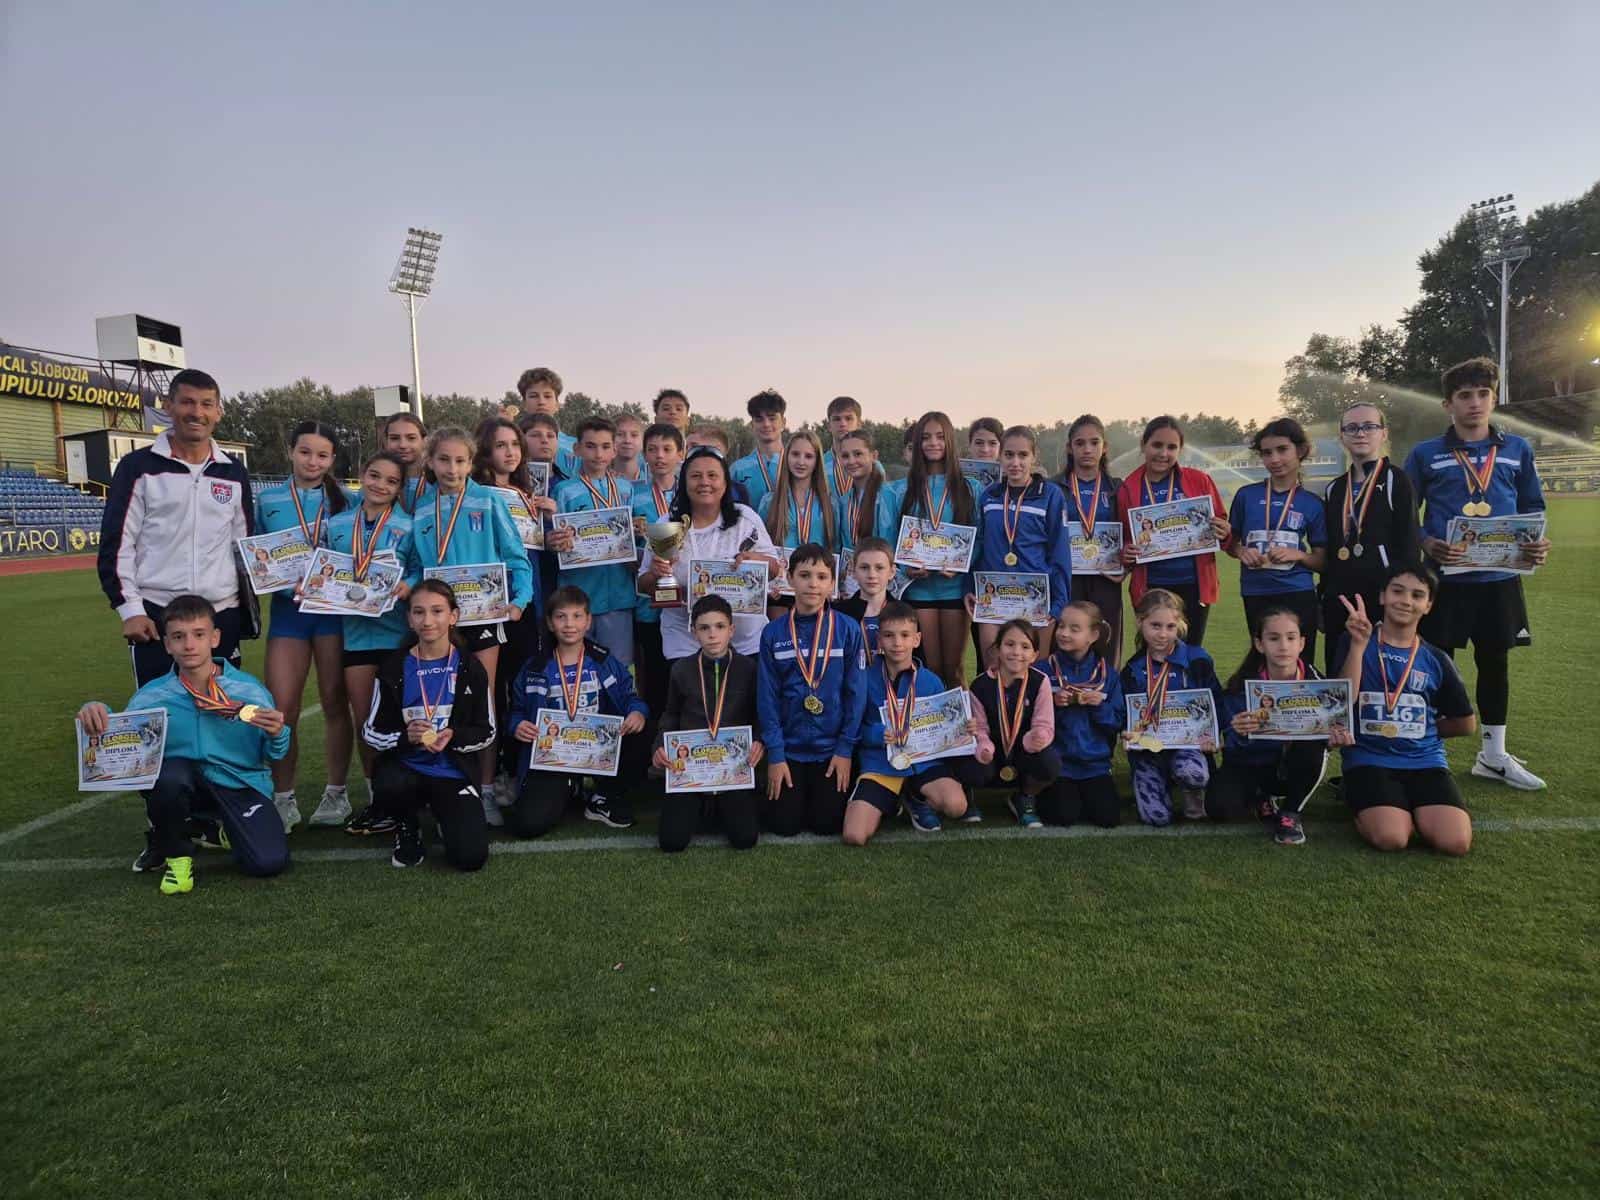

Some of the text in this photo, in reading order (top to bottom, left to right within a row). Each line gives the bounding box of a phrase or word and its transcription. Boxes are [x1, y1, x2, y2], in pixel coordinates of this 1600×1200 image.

[0, 356, 89, 384] CAL SLOBOZIA
[0, 529, 58, 552] TARO
